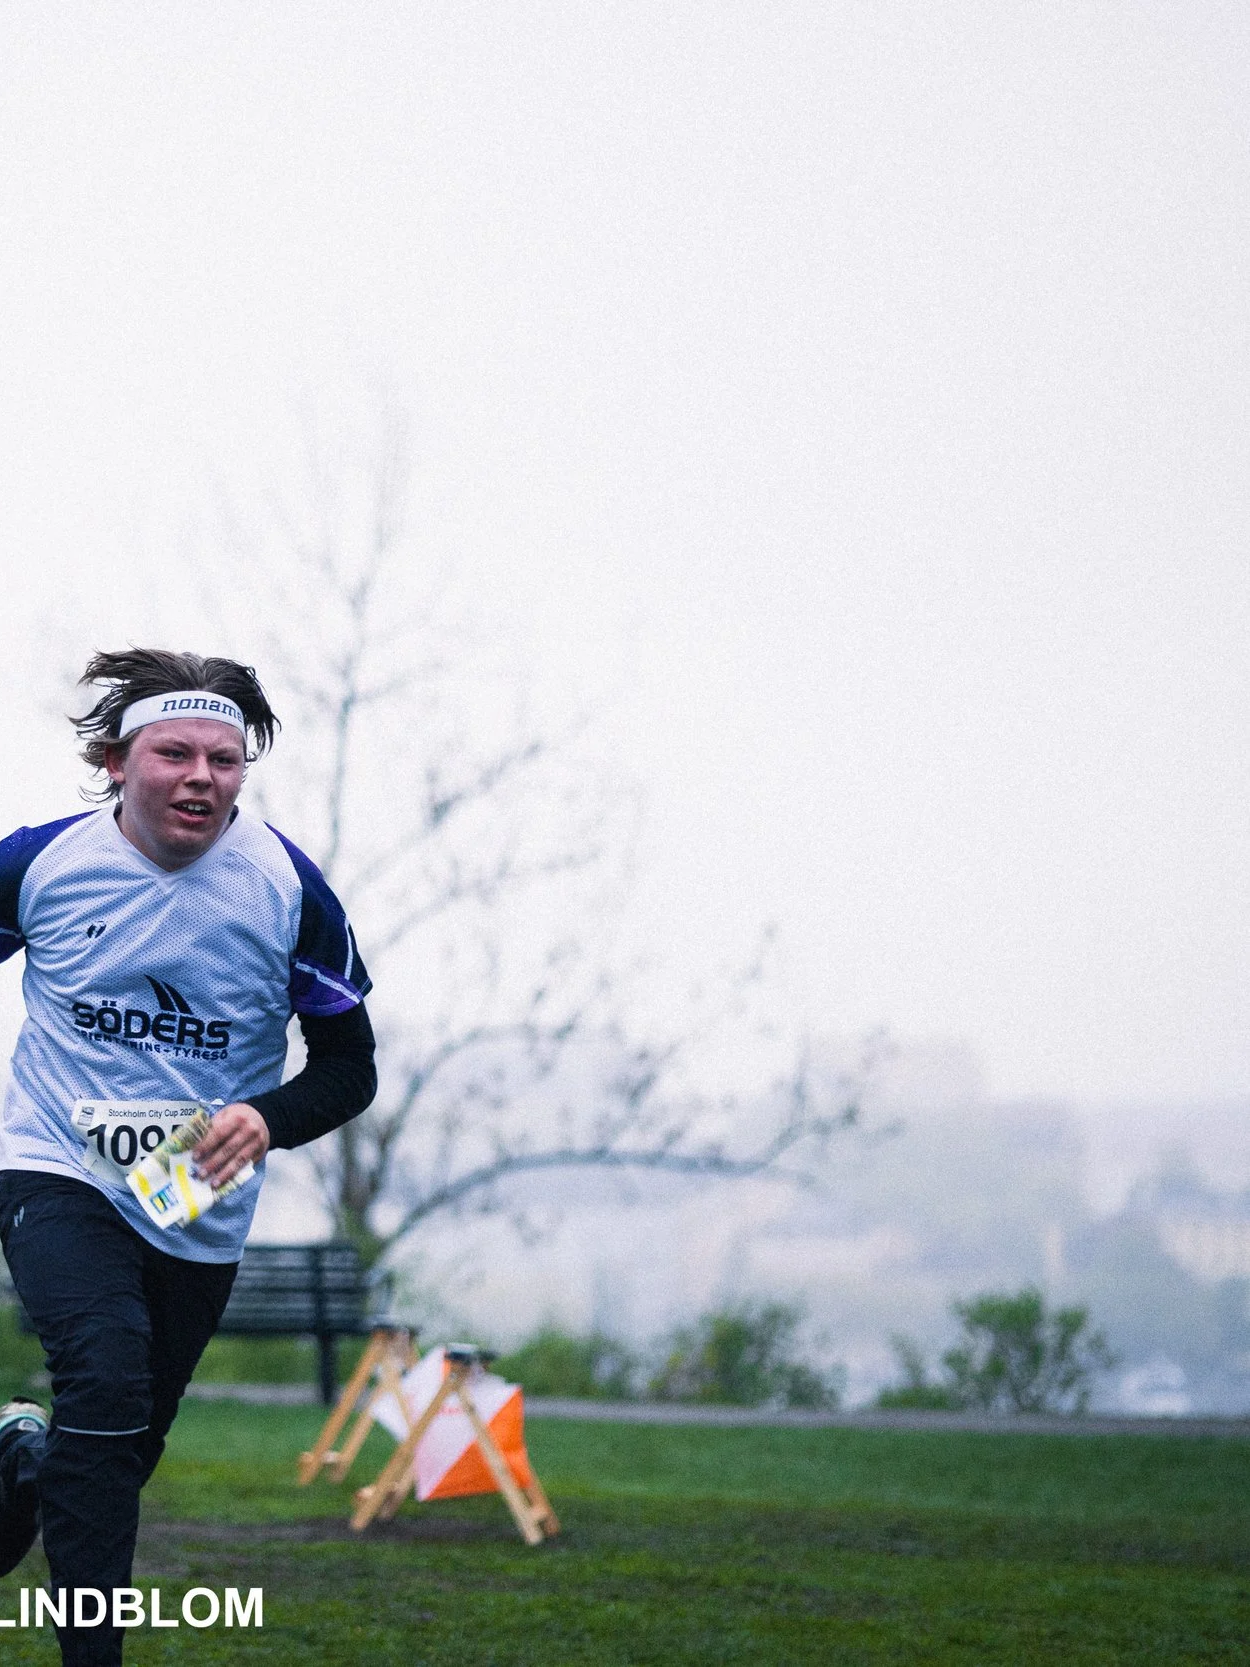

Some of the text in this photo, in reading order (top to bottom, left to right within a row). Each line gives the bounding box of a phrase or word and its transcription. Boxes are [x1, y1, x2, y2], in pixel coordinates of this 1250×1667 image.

[72, 1000, 232, 1049] SÖDERS
[108, 1108, 197, 1119] Stockholm City Cup 2026
[87, 1123, 184, 1167] 109
